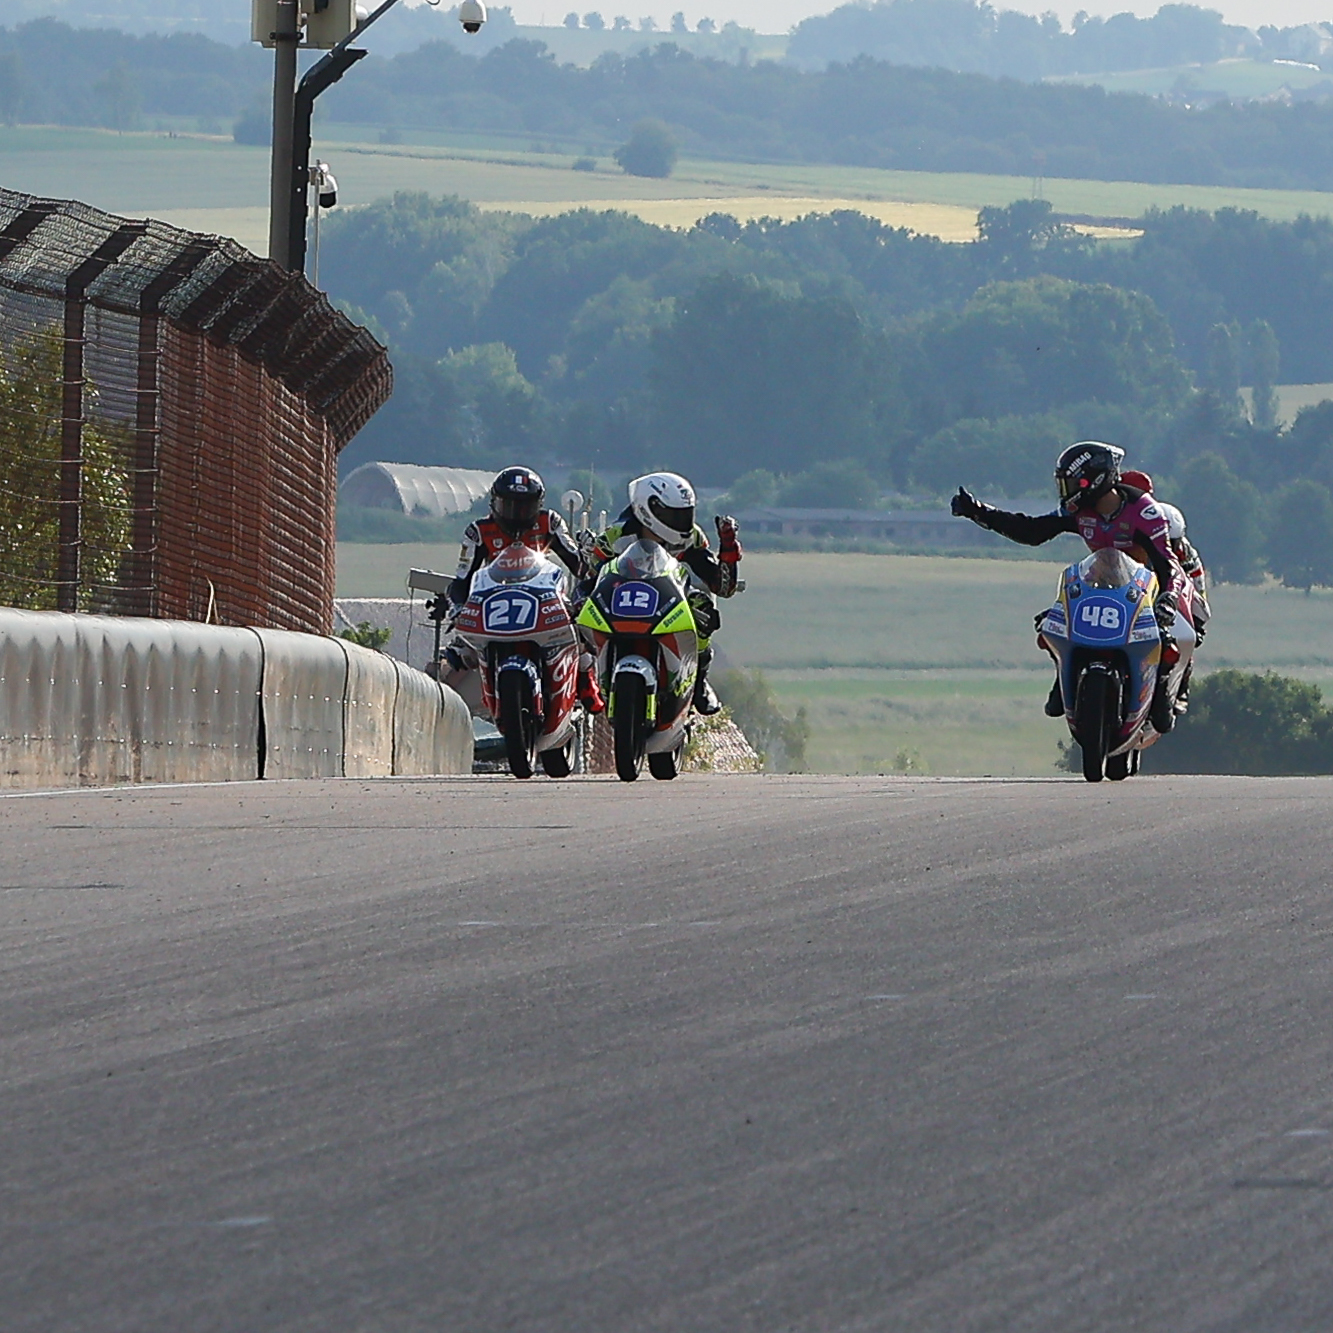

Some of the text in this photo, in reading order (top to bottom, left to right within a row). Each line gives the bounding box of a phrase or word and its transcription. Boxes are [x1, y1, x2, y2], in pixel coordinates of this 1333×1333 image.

[618, 590, 650, 608] 12
[488, 598, 532, 627] 27
[1081, 605, 1120, 629] 48
